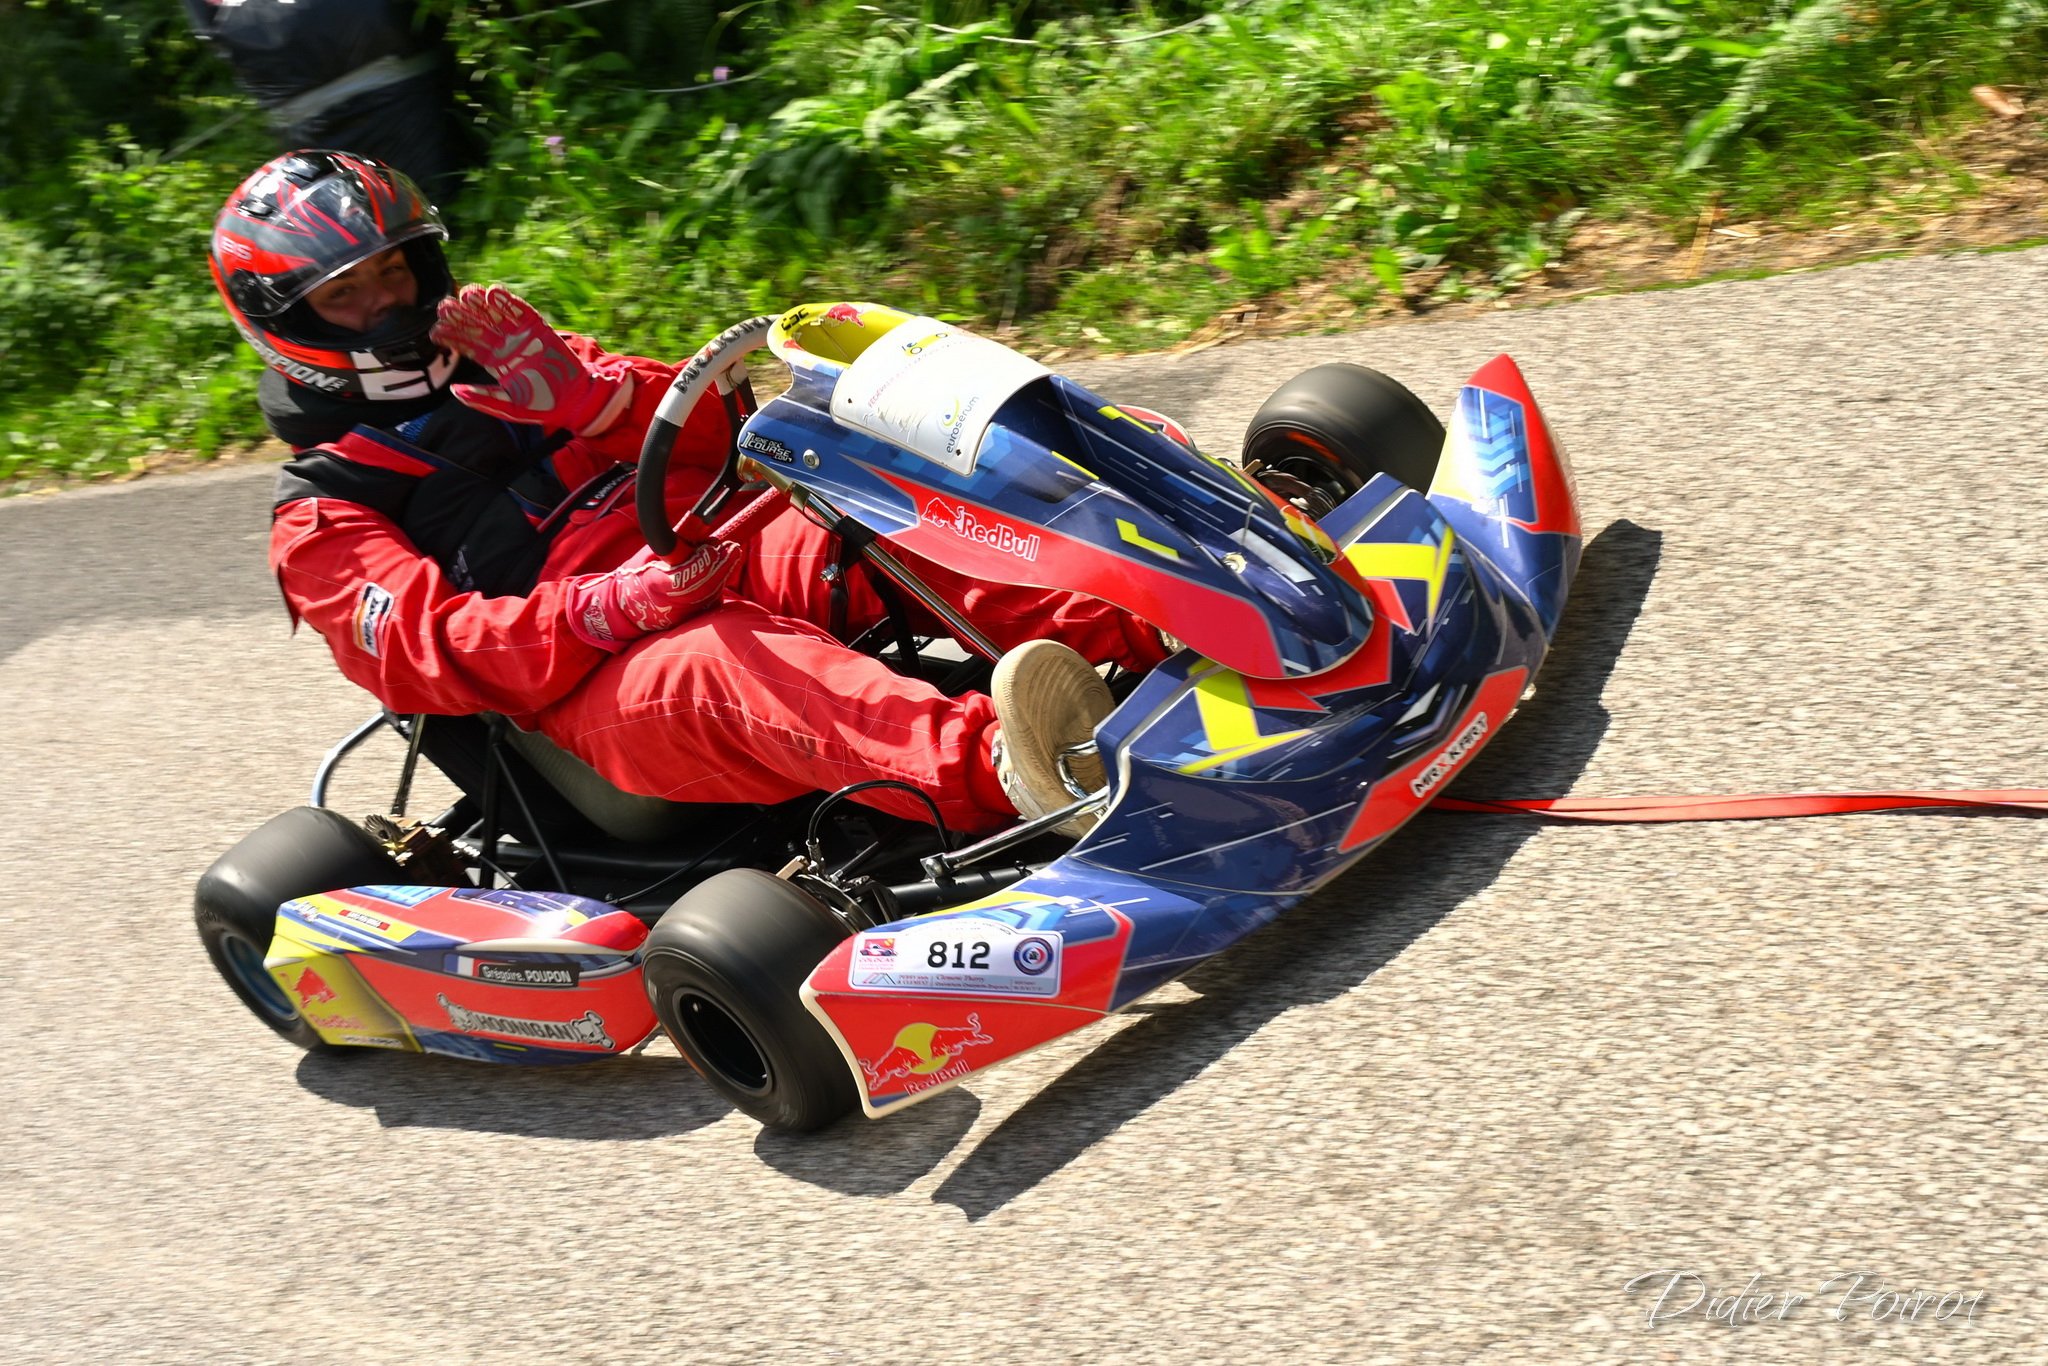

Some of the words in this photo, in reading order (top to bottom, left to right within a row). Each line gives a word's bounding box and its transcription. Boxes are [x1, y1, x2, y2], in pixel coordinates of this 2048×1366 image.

[927, 941, 991, 970] 812
[525, 969, 572, 984] POUPON
[475, 1013, 574, 1041] HOONIGAN
